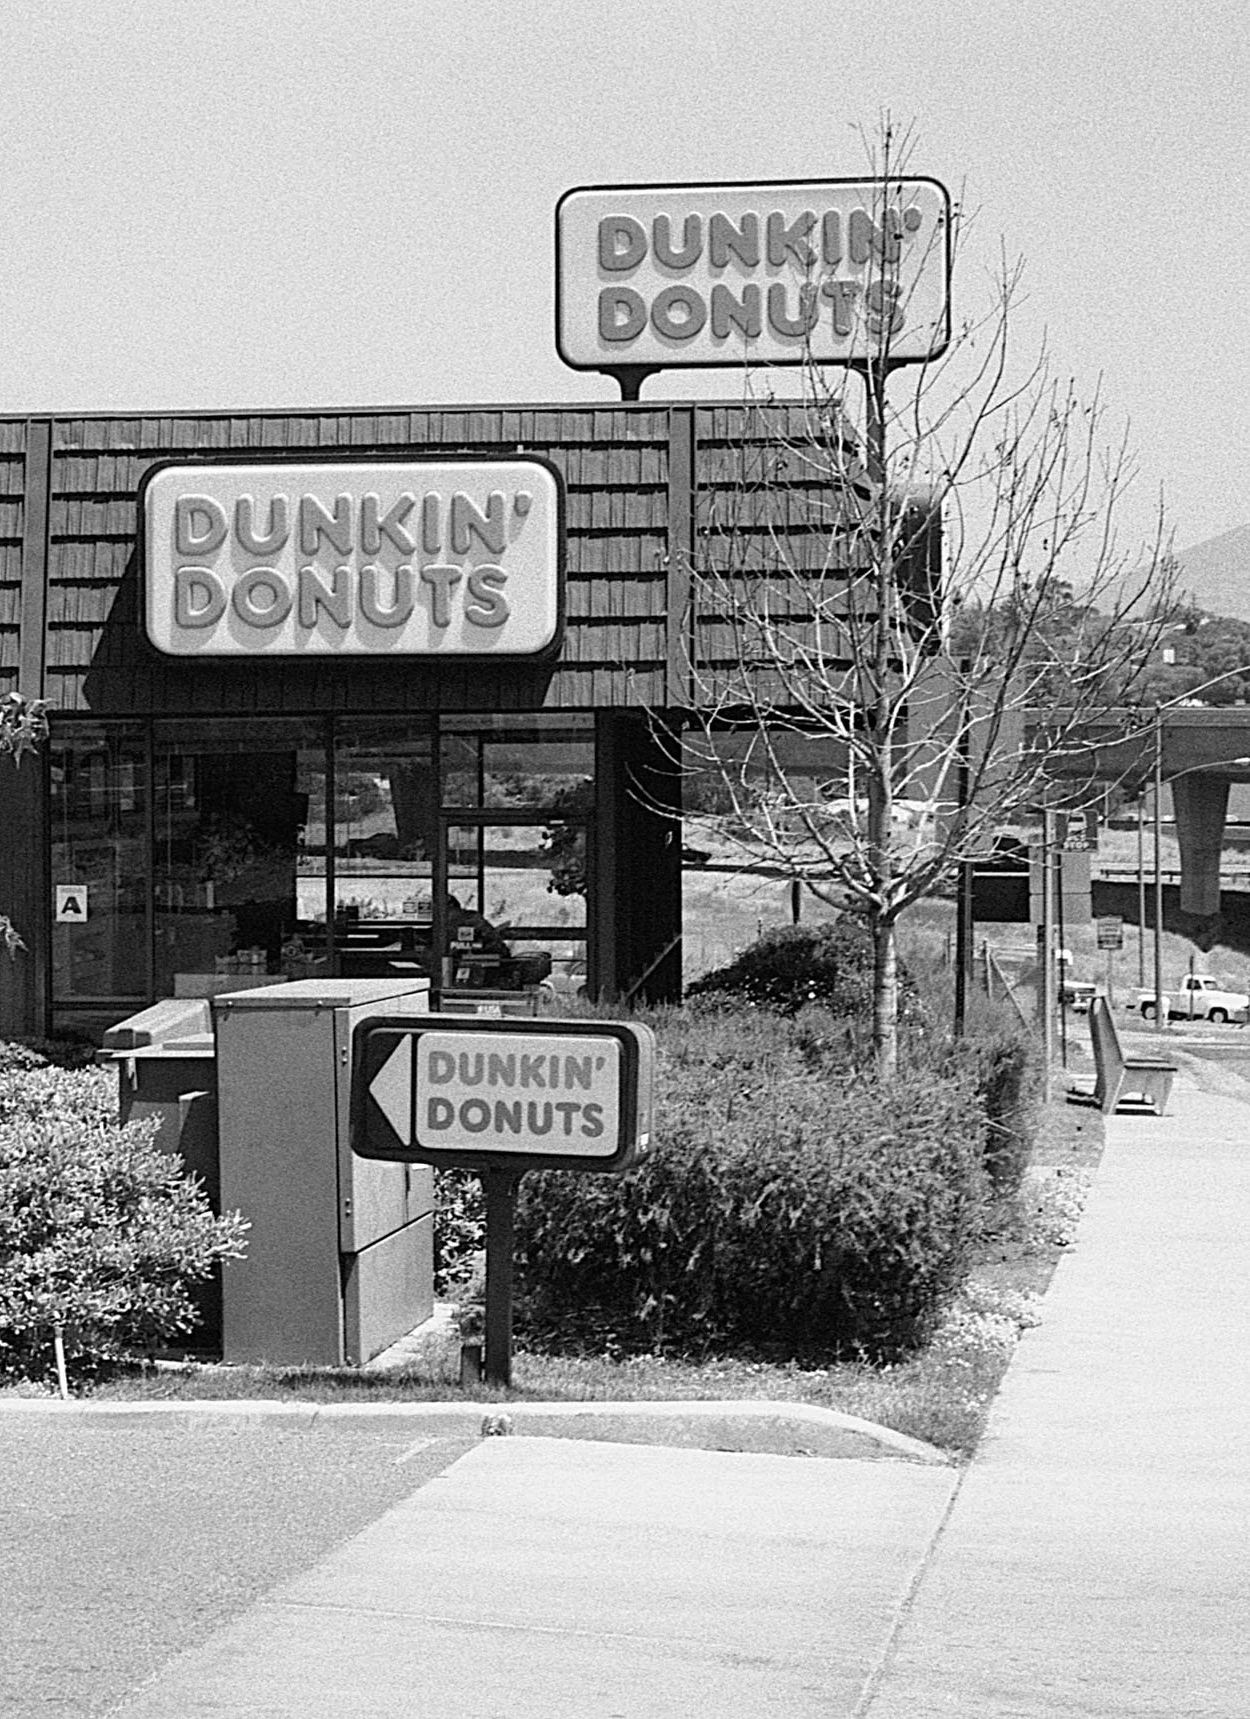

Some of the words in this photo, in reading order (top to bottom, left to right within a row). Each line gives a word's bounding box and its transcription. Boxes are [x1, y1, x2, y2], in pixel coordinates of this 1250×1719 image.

[598, 206, 922, 272] DUNKIN'
[598, 281, 905, 342] DONUTS
[175, 490, 531, 557] DUNKIN'
[175, 564, 510, 629] DONUTS
[61, 896, 82, 914] A
[428, 1051, 606, 1090] DUNKIN'
[427, 1097, 604, 1137] DONUTS
